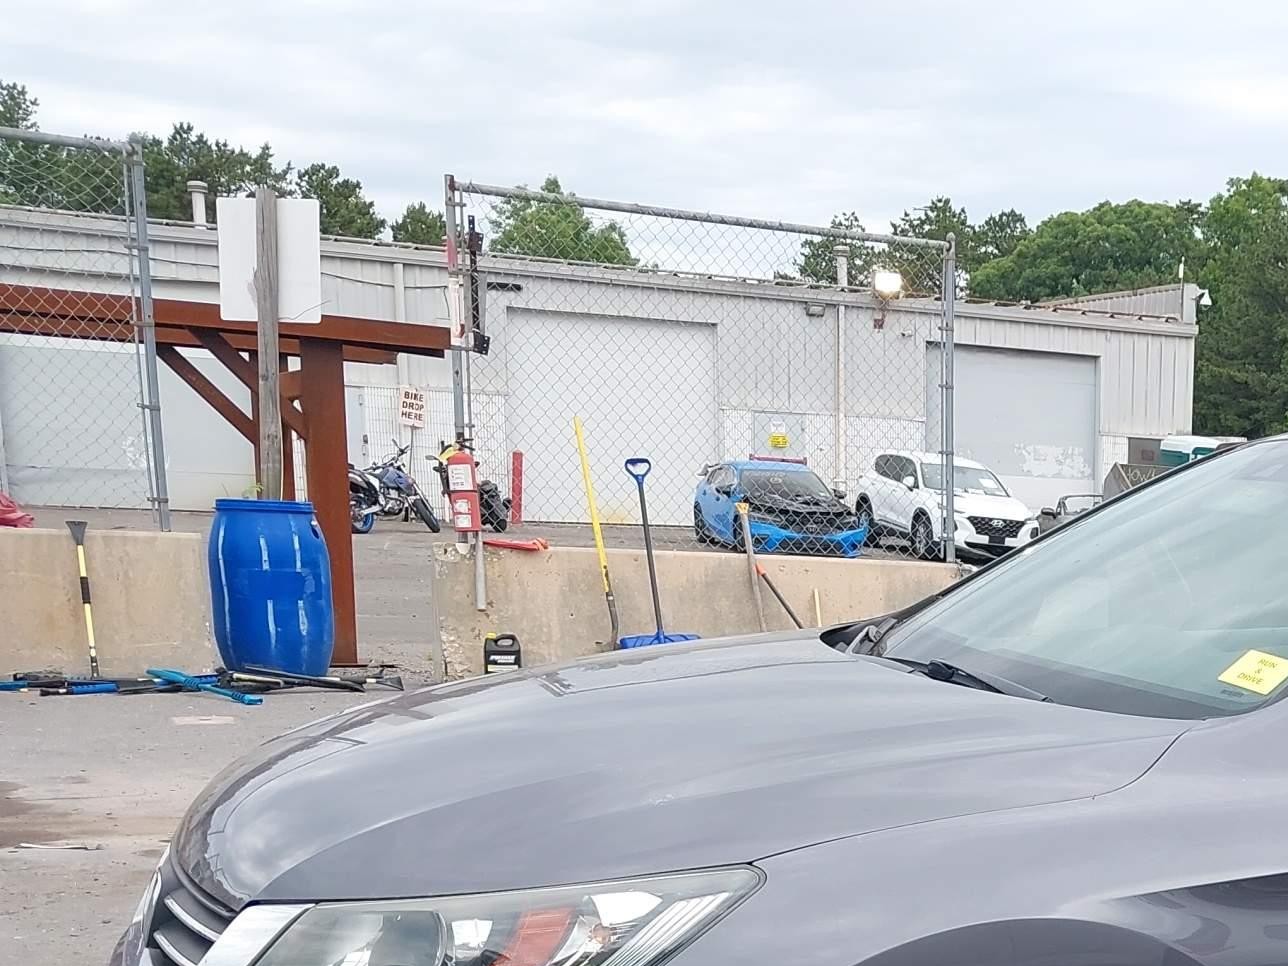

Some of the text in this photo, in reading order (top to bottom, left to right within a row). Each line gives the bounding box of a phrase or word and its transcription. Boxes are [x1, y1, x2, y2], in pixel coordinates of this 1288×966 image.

[404, 391, 424, 402] BIKE
[402, 400, 424, 411] DROP
[401, 410, 424, 422] HERE
[1257, 658, 1278, 669] RUN
[1237, 672, 1264, 685] DRIVE
